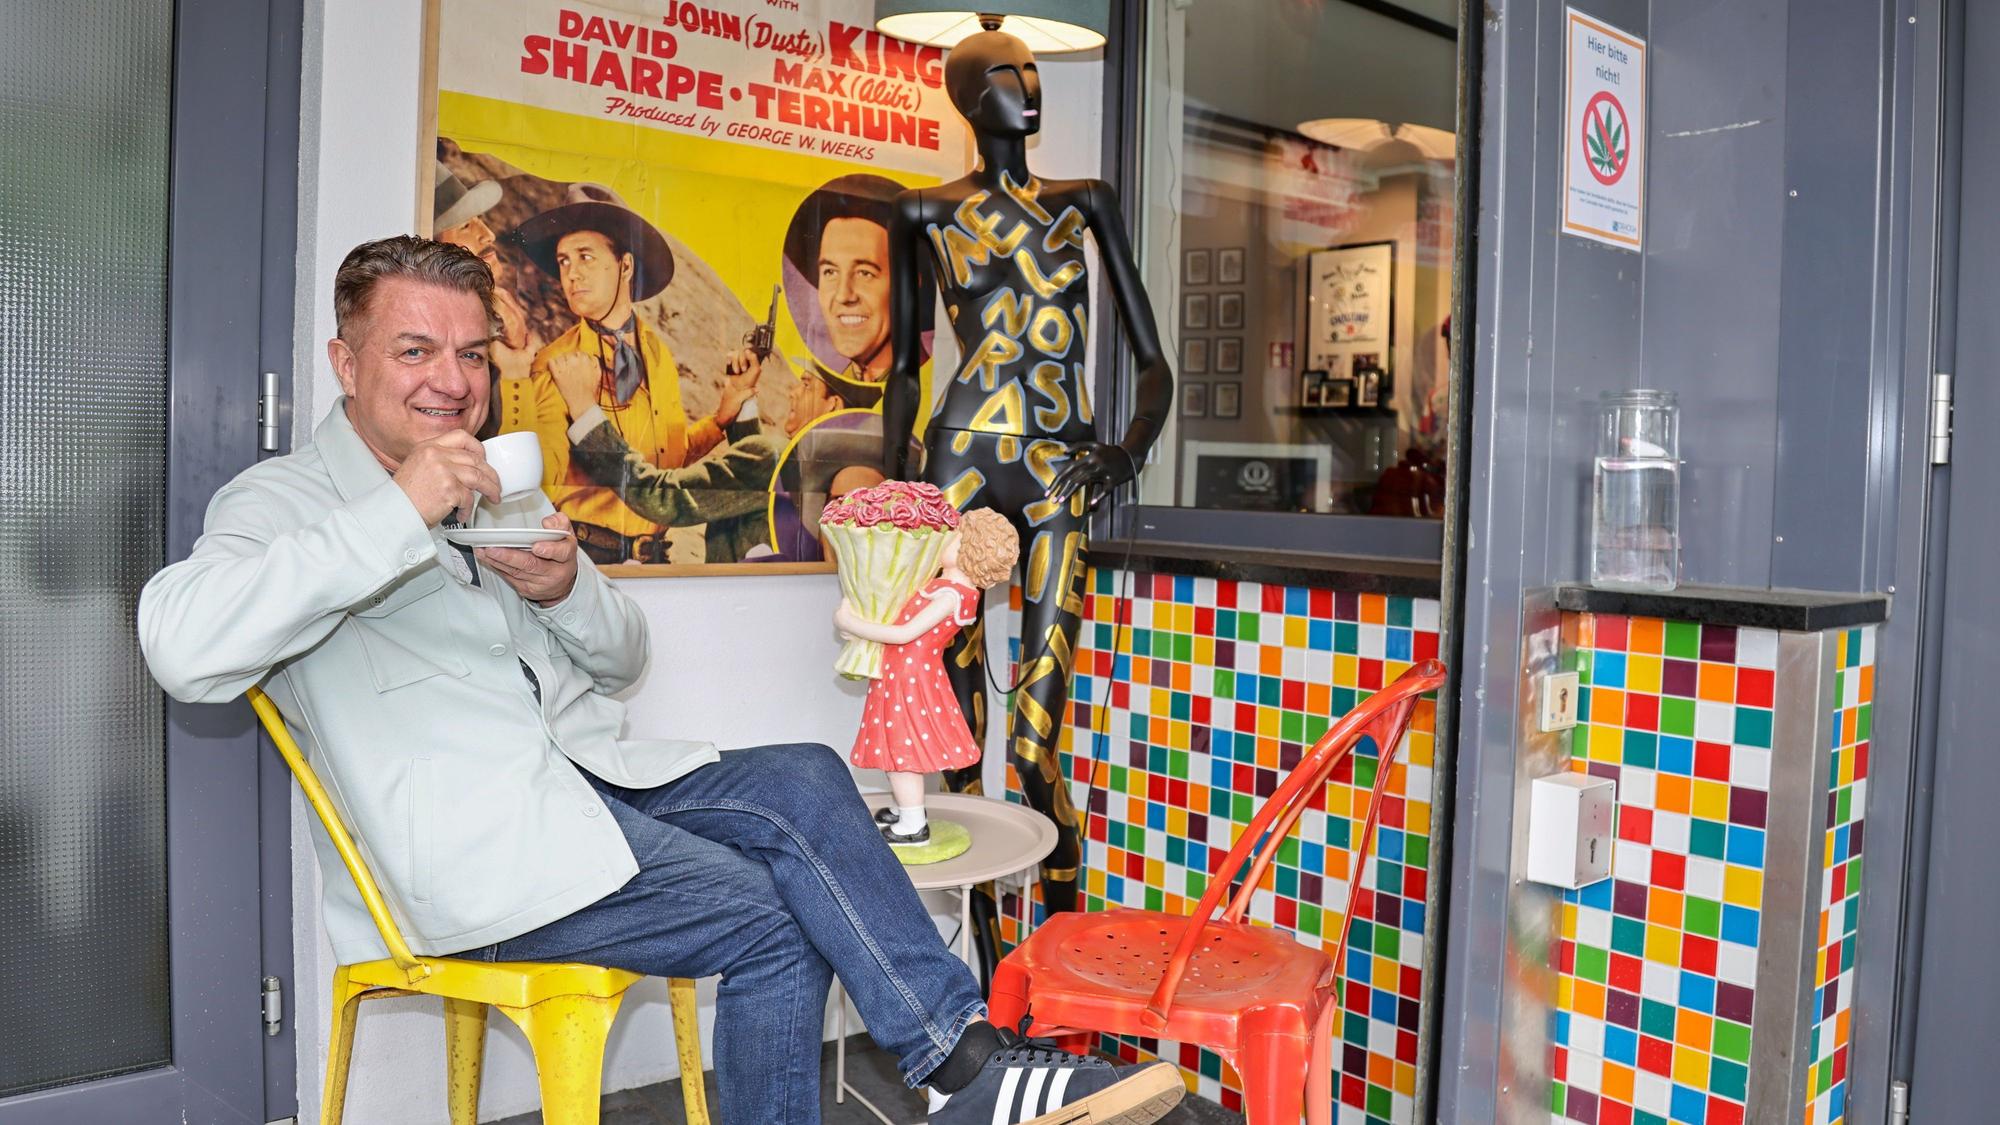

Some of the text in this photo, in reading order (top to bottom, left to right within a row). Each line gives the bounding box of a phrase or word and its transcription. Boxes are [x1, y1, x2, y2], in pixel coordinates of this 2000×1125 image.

[767, 0, 798, 11] WITH
[559, 9, 678, 59] DAVID
[663, 0, 943, 89] JOHN (Dusty) KING
[1587, 35, 1628, 64] Hier bitte
[521, 35, 940, 151] SHARPE TERHUNE
[773, 58, 847, 98] MAX
[1596, 65, 1620, 85] nicht!
[604, 97, 875, 161] Produced by GEORGE W. WEEKS
